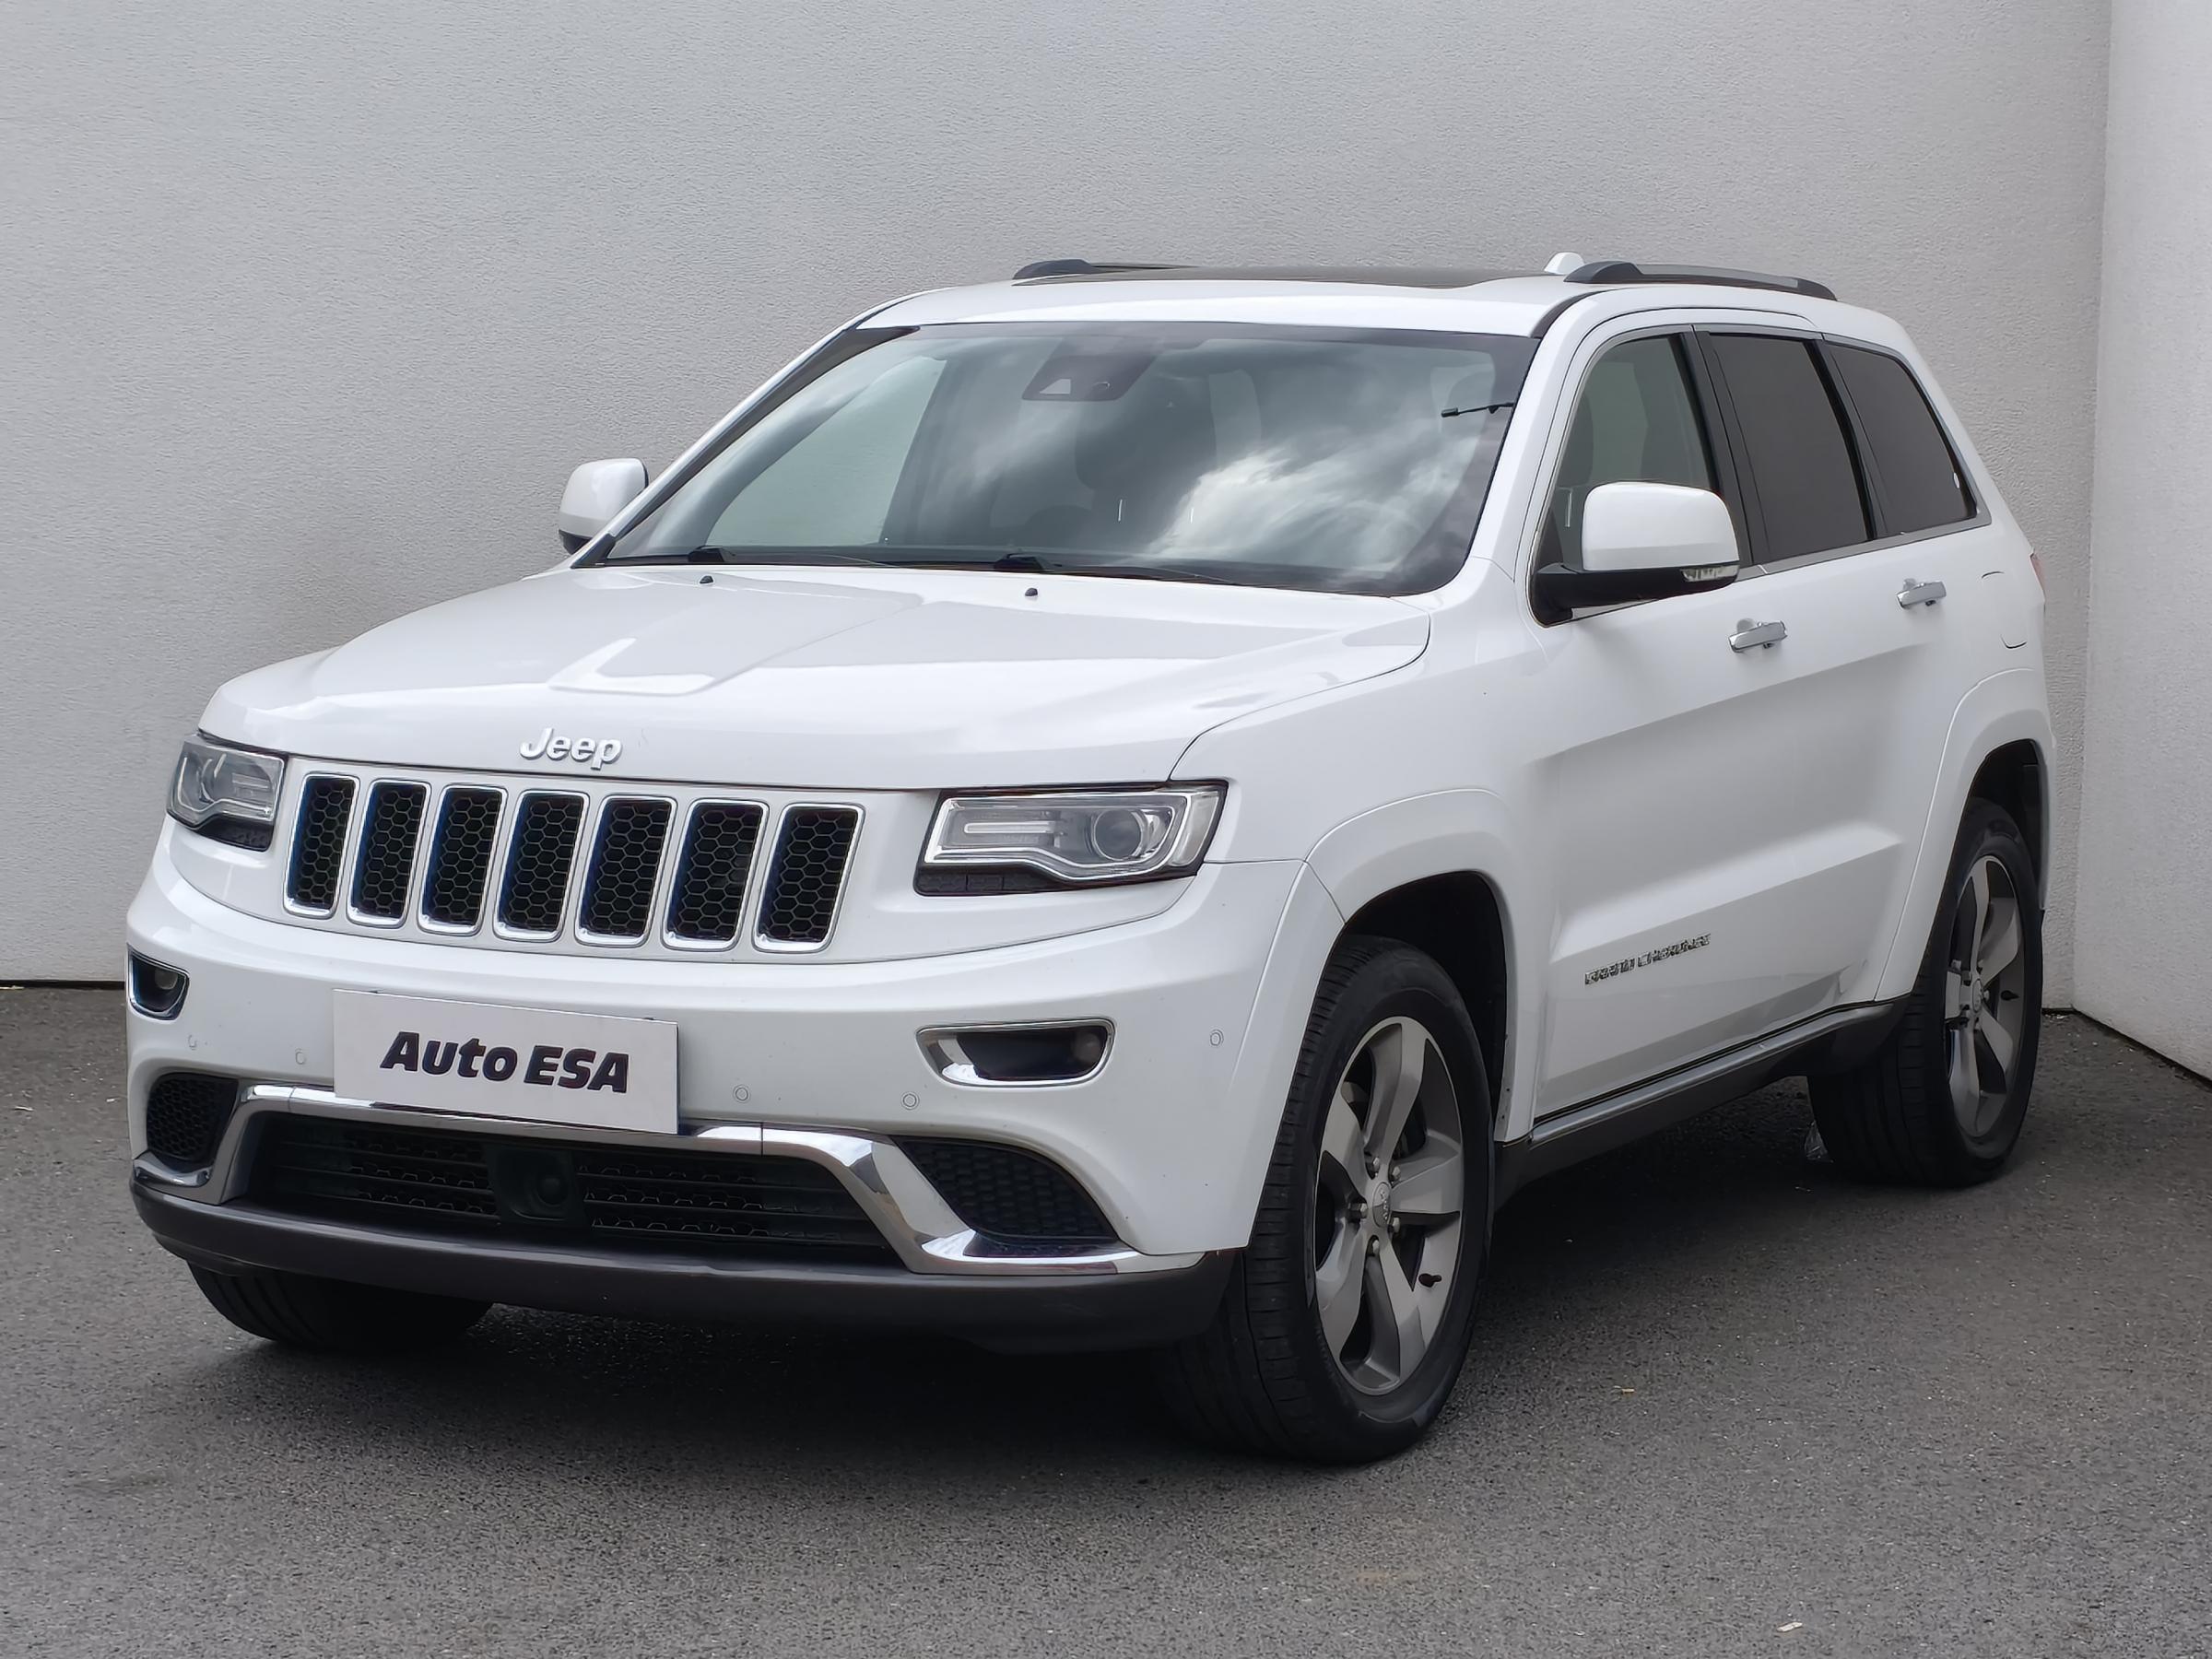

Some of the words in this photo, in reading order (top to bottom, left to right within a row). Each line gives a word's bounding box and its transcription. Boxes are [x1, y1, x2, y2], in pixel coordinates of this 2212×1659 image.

[520, 727, 622, 771] Jeep
[379, 1031, 518, 1082] Auto
[524, 1044, 629, 1094] ESA
